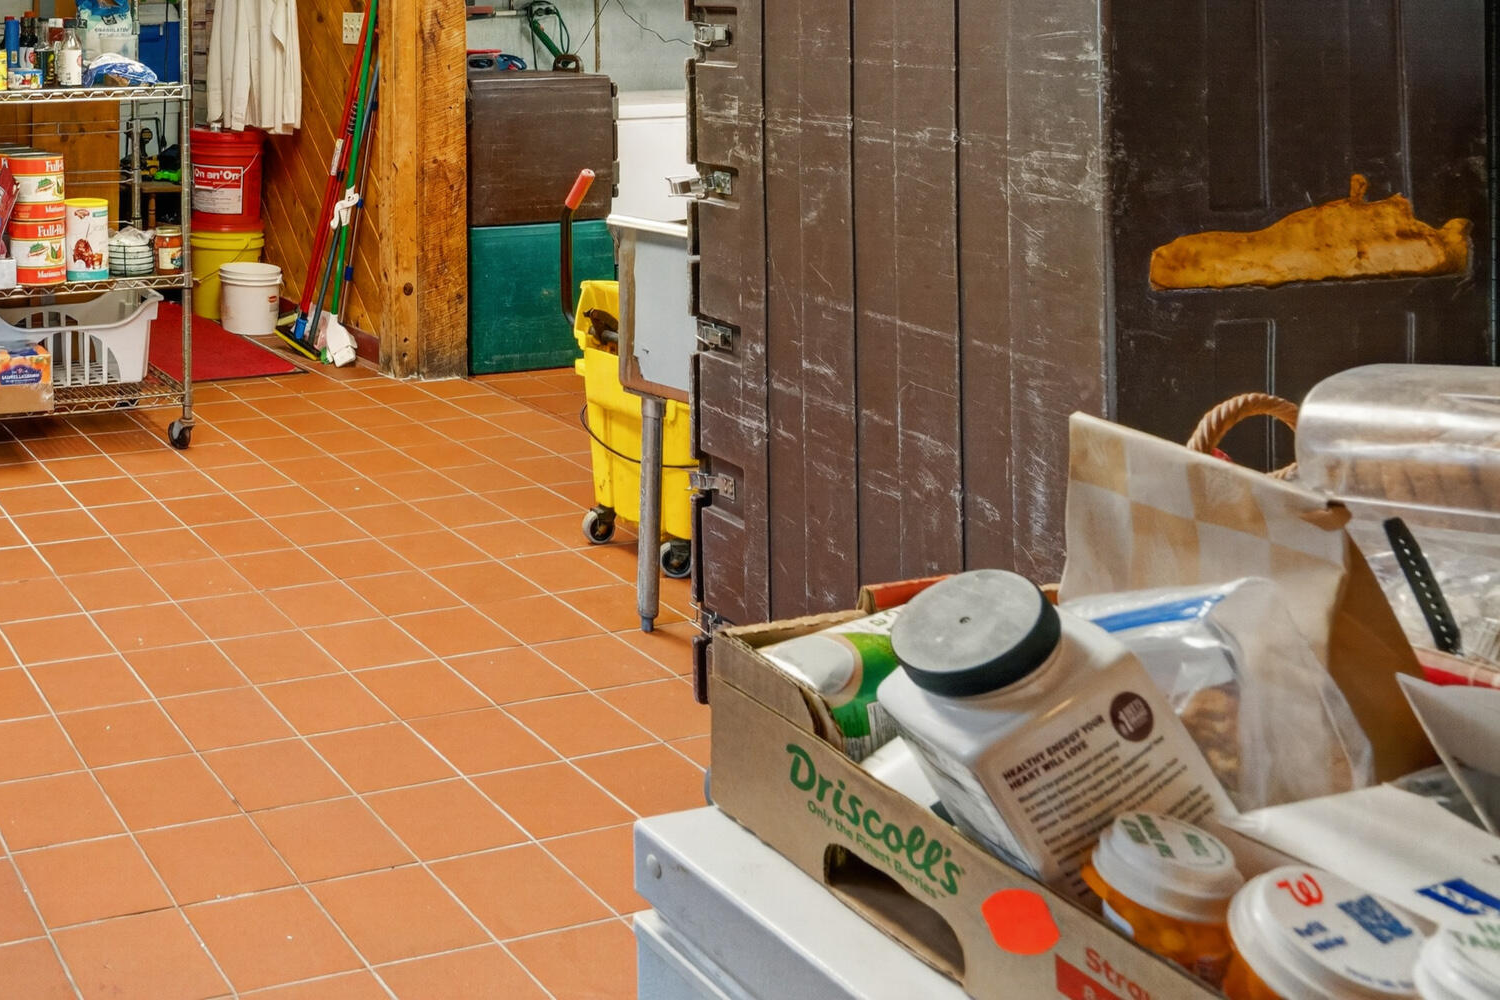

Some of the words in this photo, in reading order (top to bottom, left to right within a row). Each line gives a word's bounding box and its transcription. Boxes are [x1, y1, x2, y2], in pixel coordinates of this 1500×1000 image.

[1002, 752, 1047, 781] HEALTHY
[1045, 729, 1080, 757] ENERGY
[1081, 714, 1106, 735] YOUR
[1008, 769, 1042, 792] HEART
[1042, 756, 1065, 774] WILL
[1064, 740, 1089, 760] LOVE
[785, 743, 959, 896] Driscoll's
[807, 800, 832, 828] Only
[835, 816, 854, 841] the
[855, 832, 892, 868] Finest
